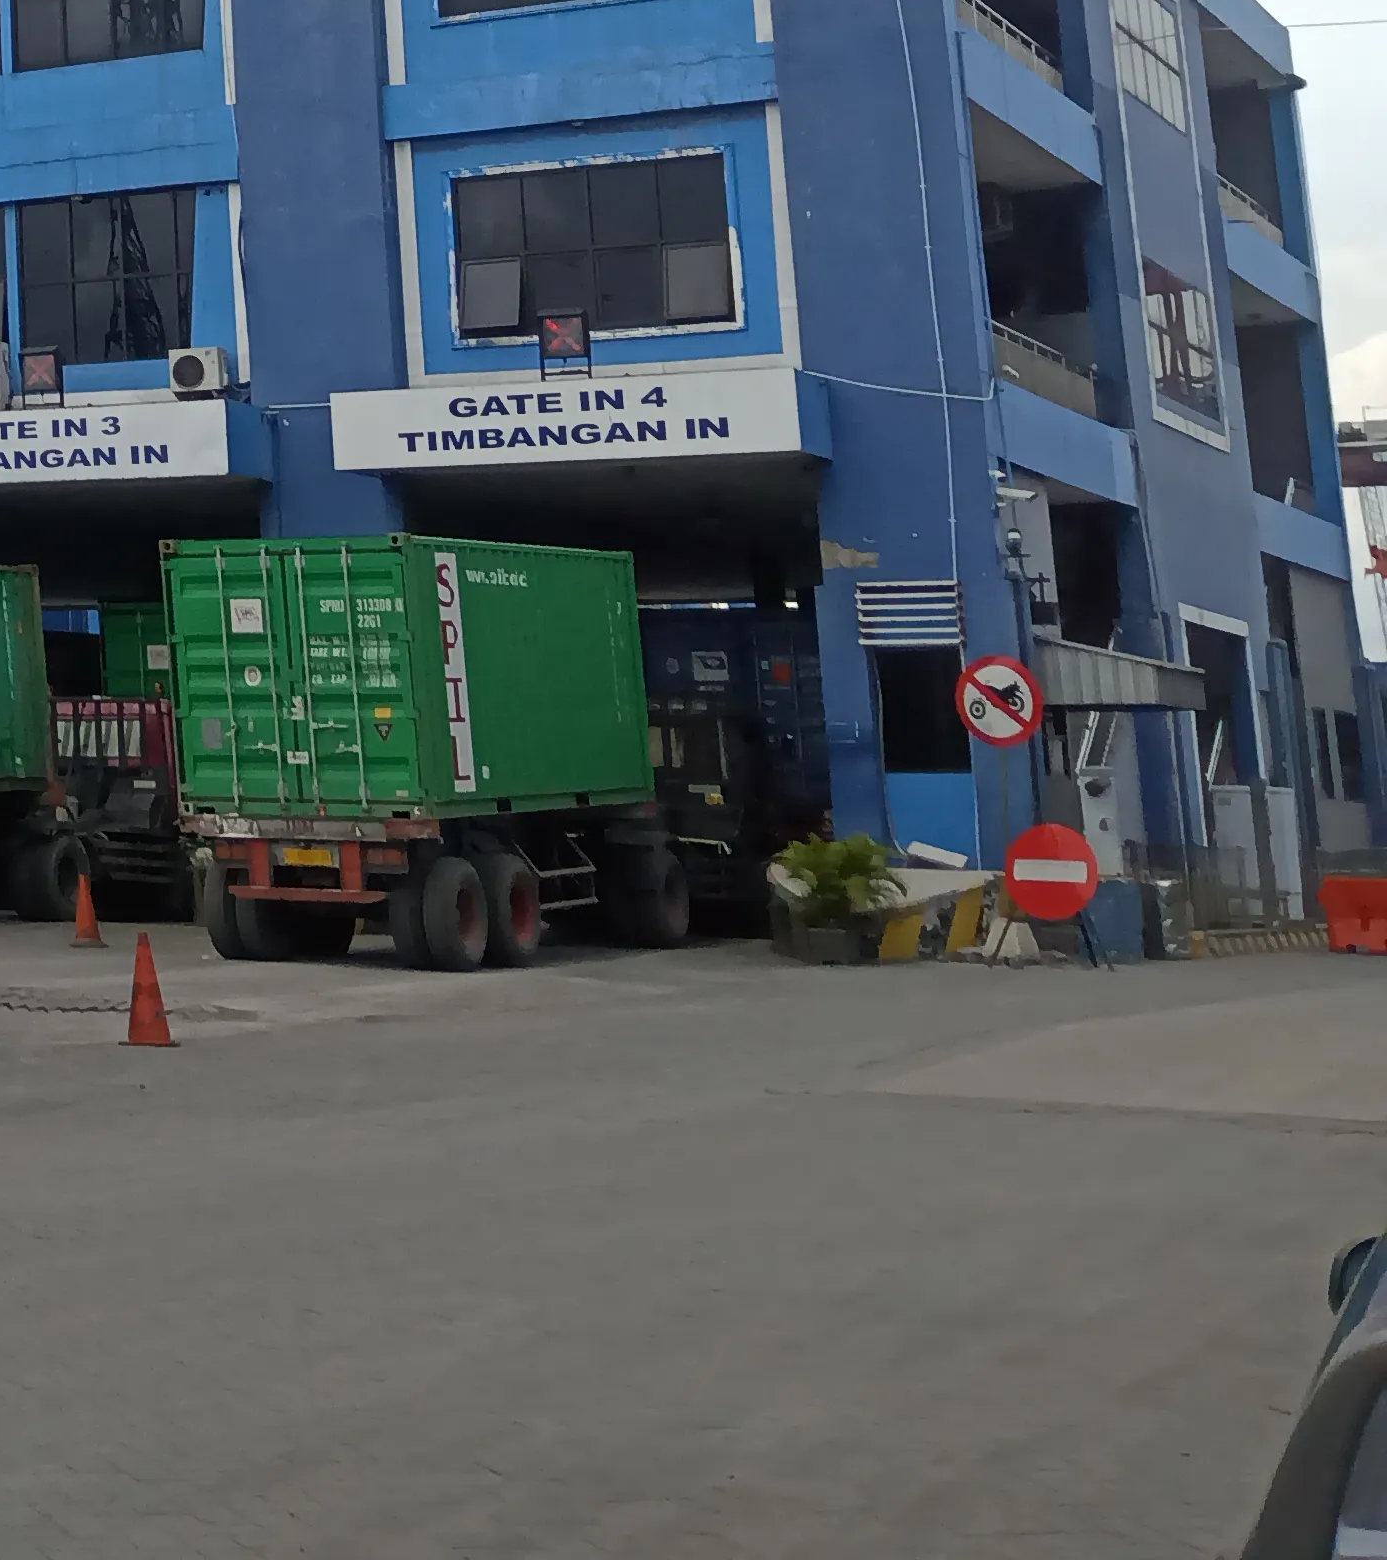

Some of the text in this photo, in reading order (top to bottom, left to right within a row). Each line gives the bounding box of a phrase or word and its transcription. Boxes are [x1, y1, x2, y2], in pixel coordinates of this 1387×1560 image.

[449, 387, 667, 418] GATE IN 4
[51, 418, 88, 438] IN
[101, 416, 121, 435] 3
[398, 416, 730, 453] TIMBANGAN IN
[130, 444, 169, 464] IN
[436, 562, 471, 781] SPIL
